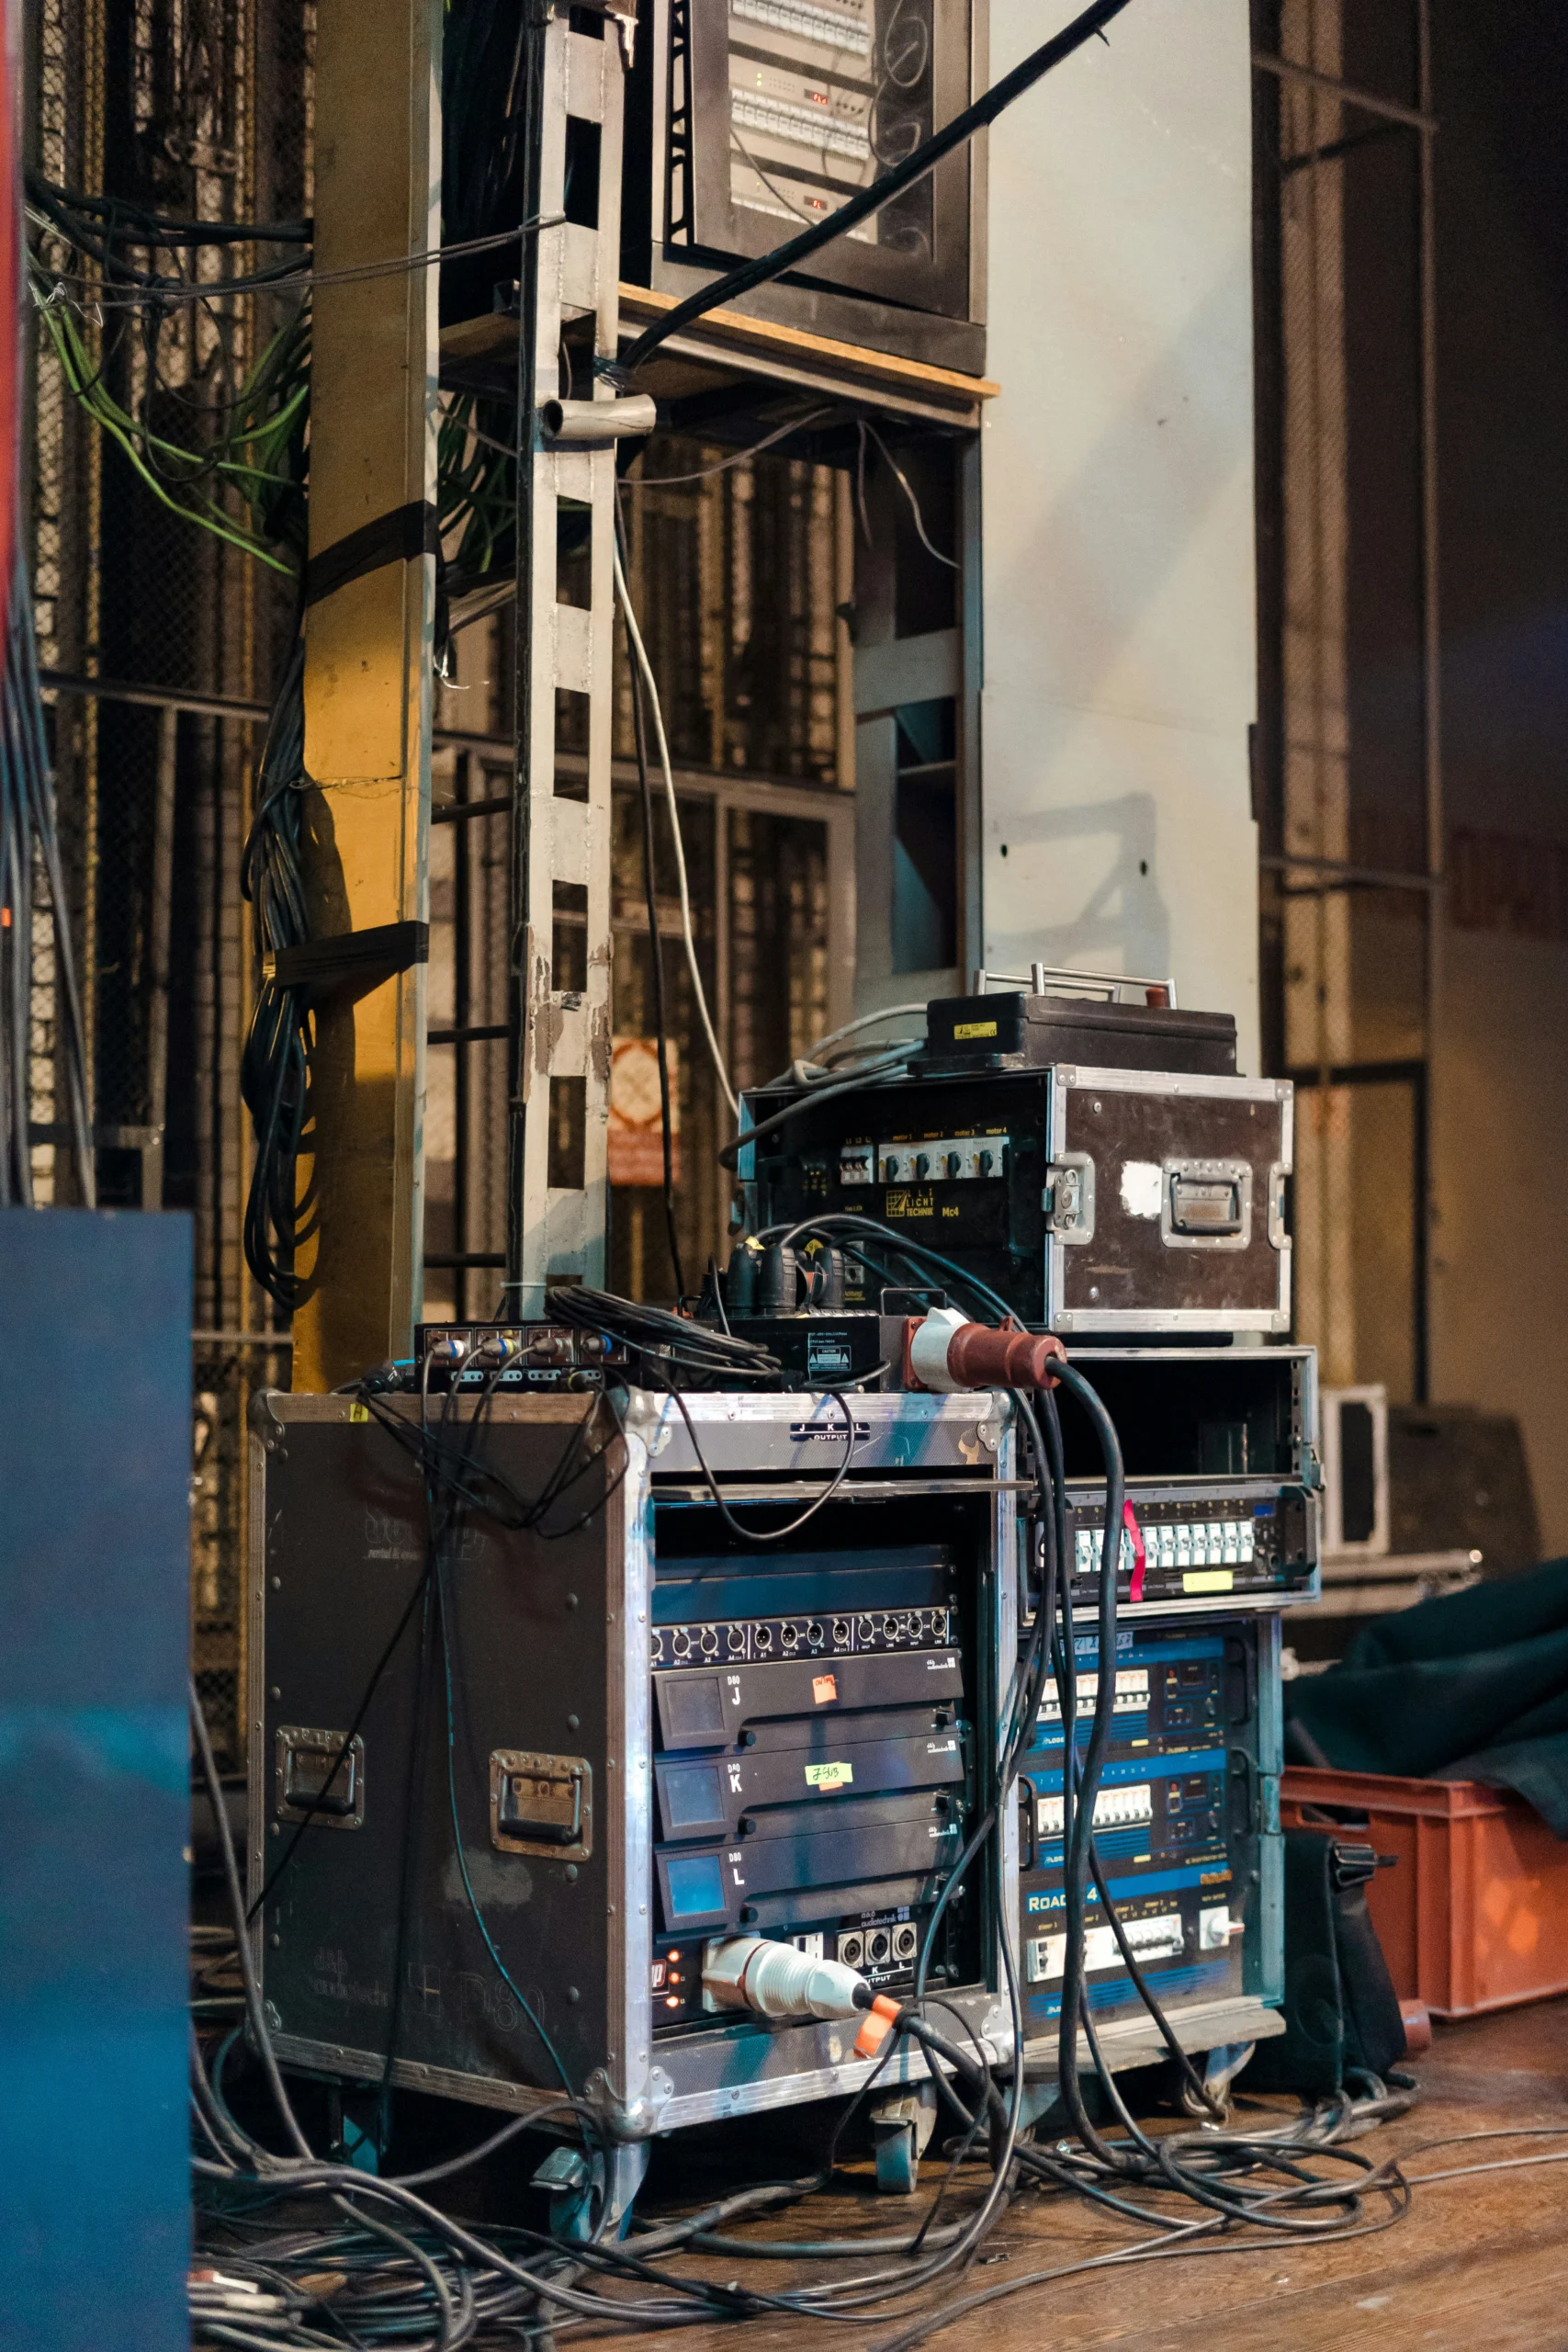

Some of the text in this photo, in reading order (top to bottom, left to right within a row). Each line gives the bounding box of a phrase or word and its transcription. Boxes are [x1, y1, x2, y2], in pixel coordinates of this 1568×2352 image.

[906, 1198, 933, 1207] LICHT
[907, 1207, 933, 1216] TECHNIK
[942, 1207, 959, 1216] Mc4
[728, 1675, 740, 1685] D80
[731, 1687, 740, 1705] J
[728, 1763, 740, 1773] D80
[729, 1774, 742, 1793] K
[729, 1852, 741, 1862] D80
[733, 1869, 745, 1885] L
[862, 1913, 897, 1928] audiotechnik
[872, 1961, 905, 1974] K L
